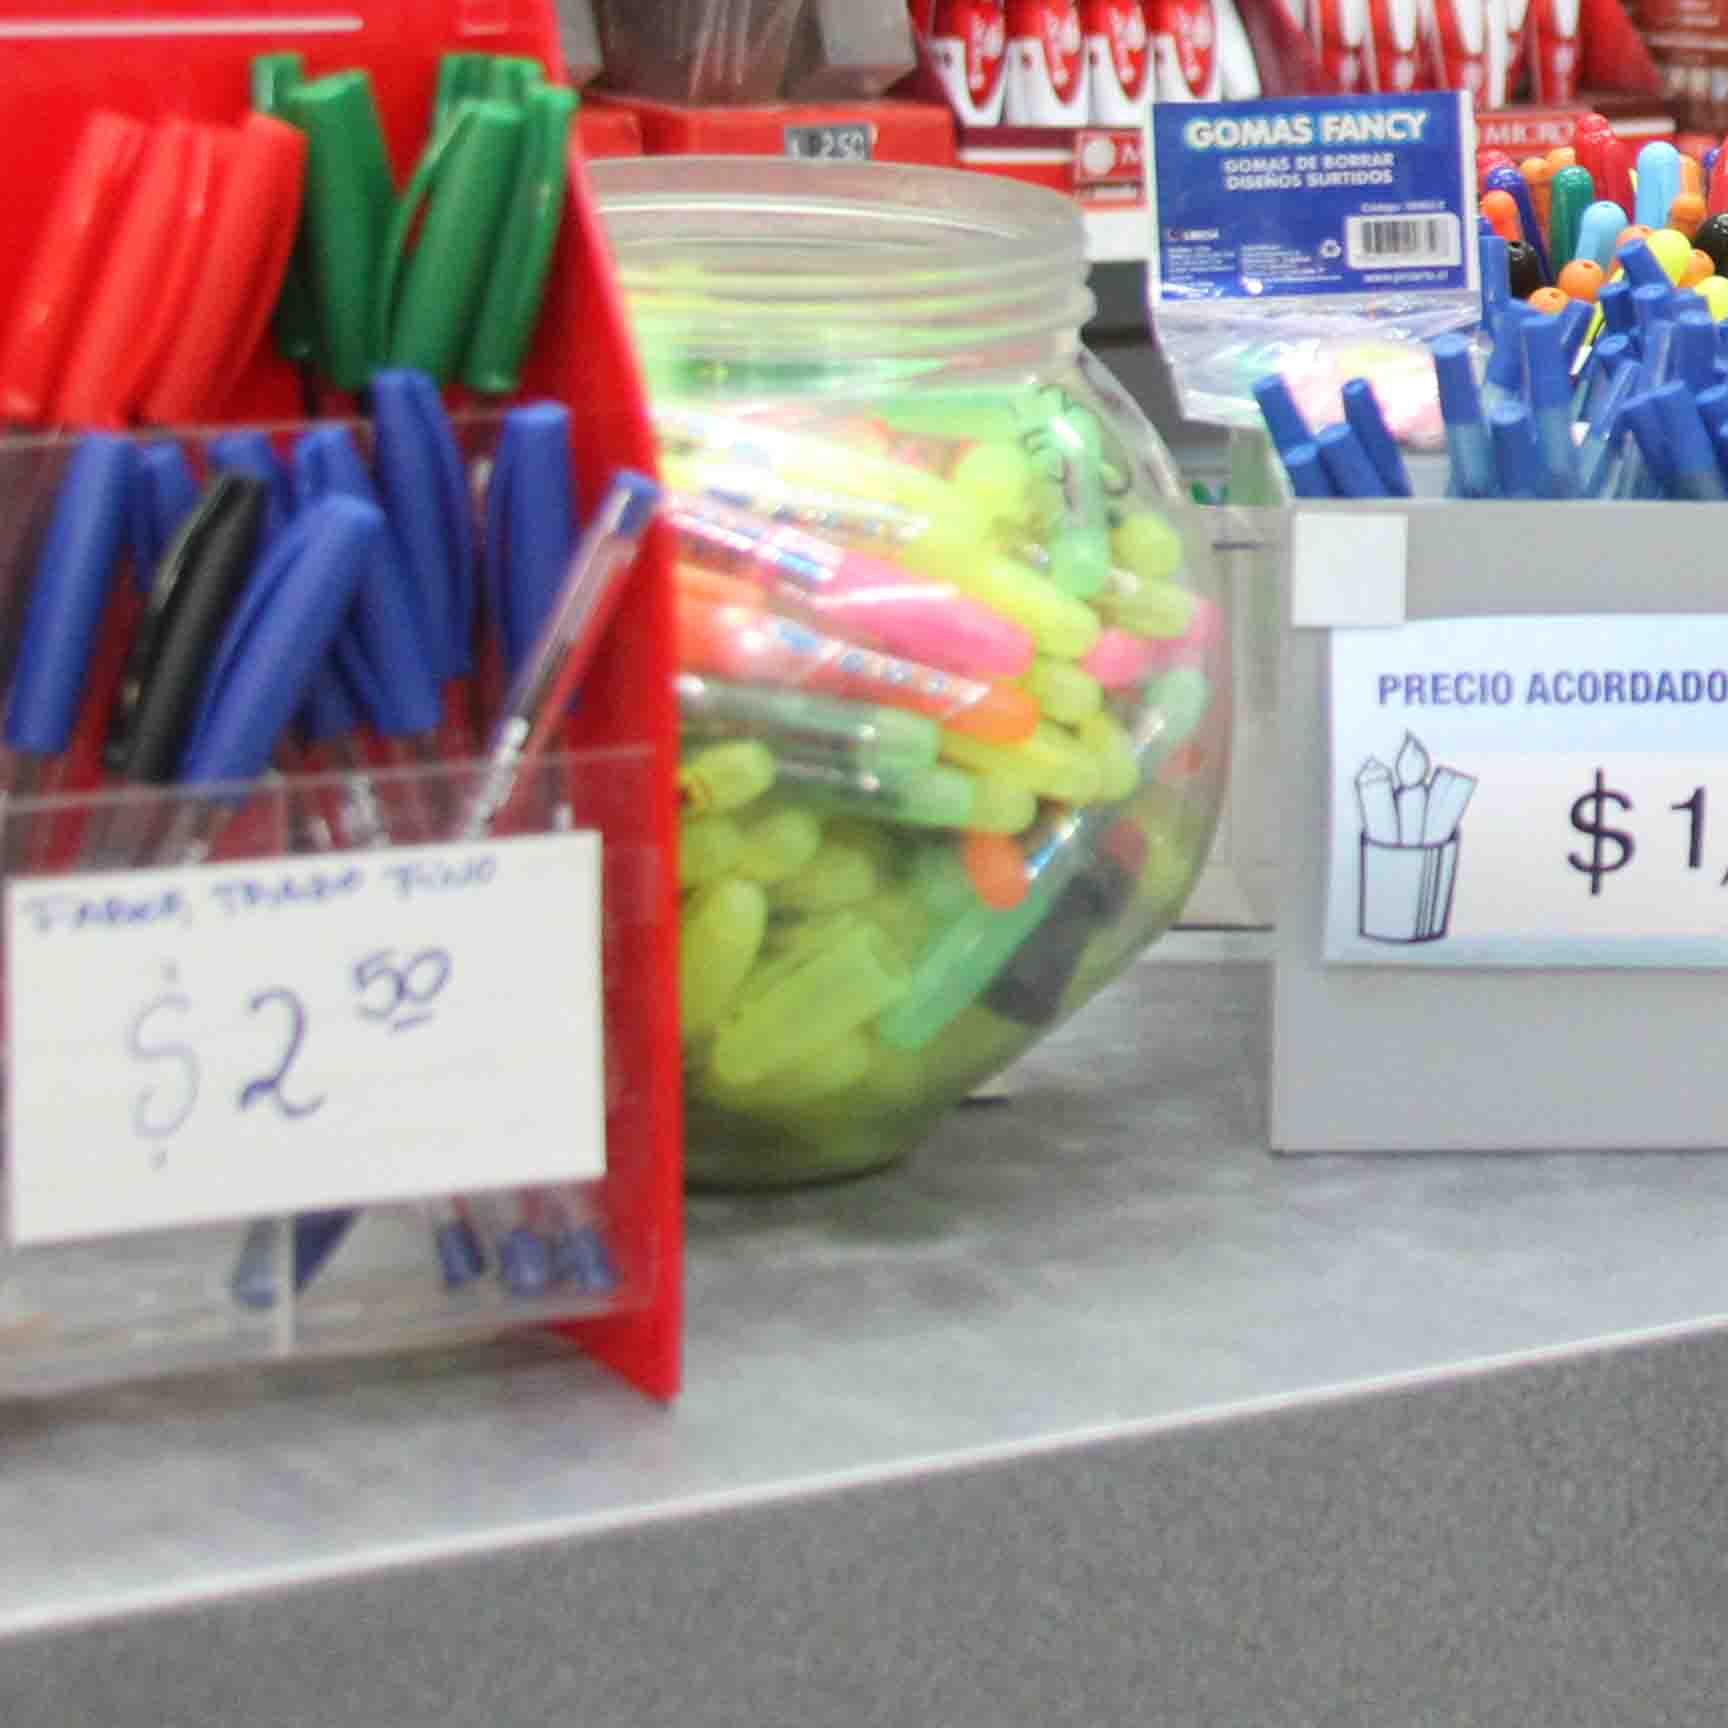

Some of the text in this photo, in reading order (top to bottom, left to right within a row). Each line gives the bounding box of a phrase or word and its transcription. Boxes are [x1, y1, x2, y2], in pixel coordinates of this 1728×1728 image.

[1186, 113, 1428, 148] GOMAS FANCY
[1484, 124, 1577, 145] MICRO
[1224, 153, 1394, 174] GOMAS DE BORRAR
[1226, 170, 1393, 191] DISEÑOS SURTIDOS
[1378, 672, 1728, 706] PRECIO ACORDADO
[1566, 768, 1634, 896] $
[237, 986, 326, 1119] 2
[352, 946, 454, 1032] 50
